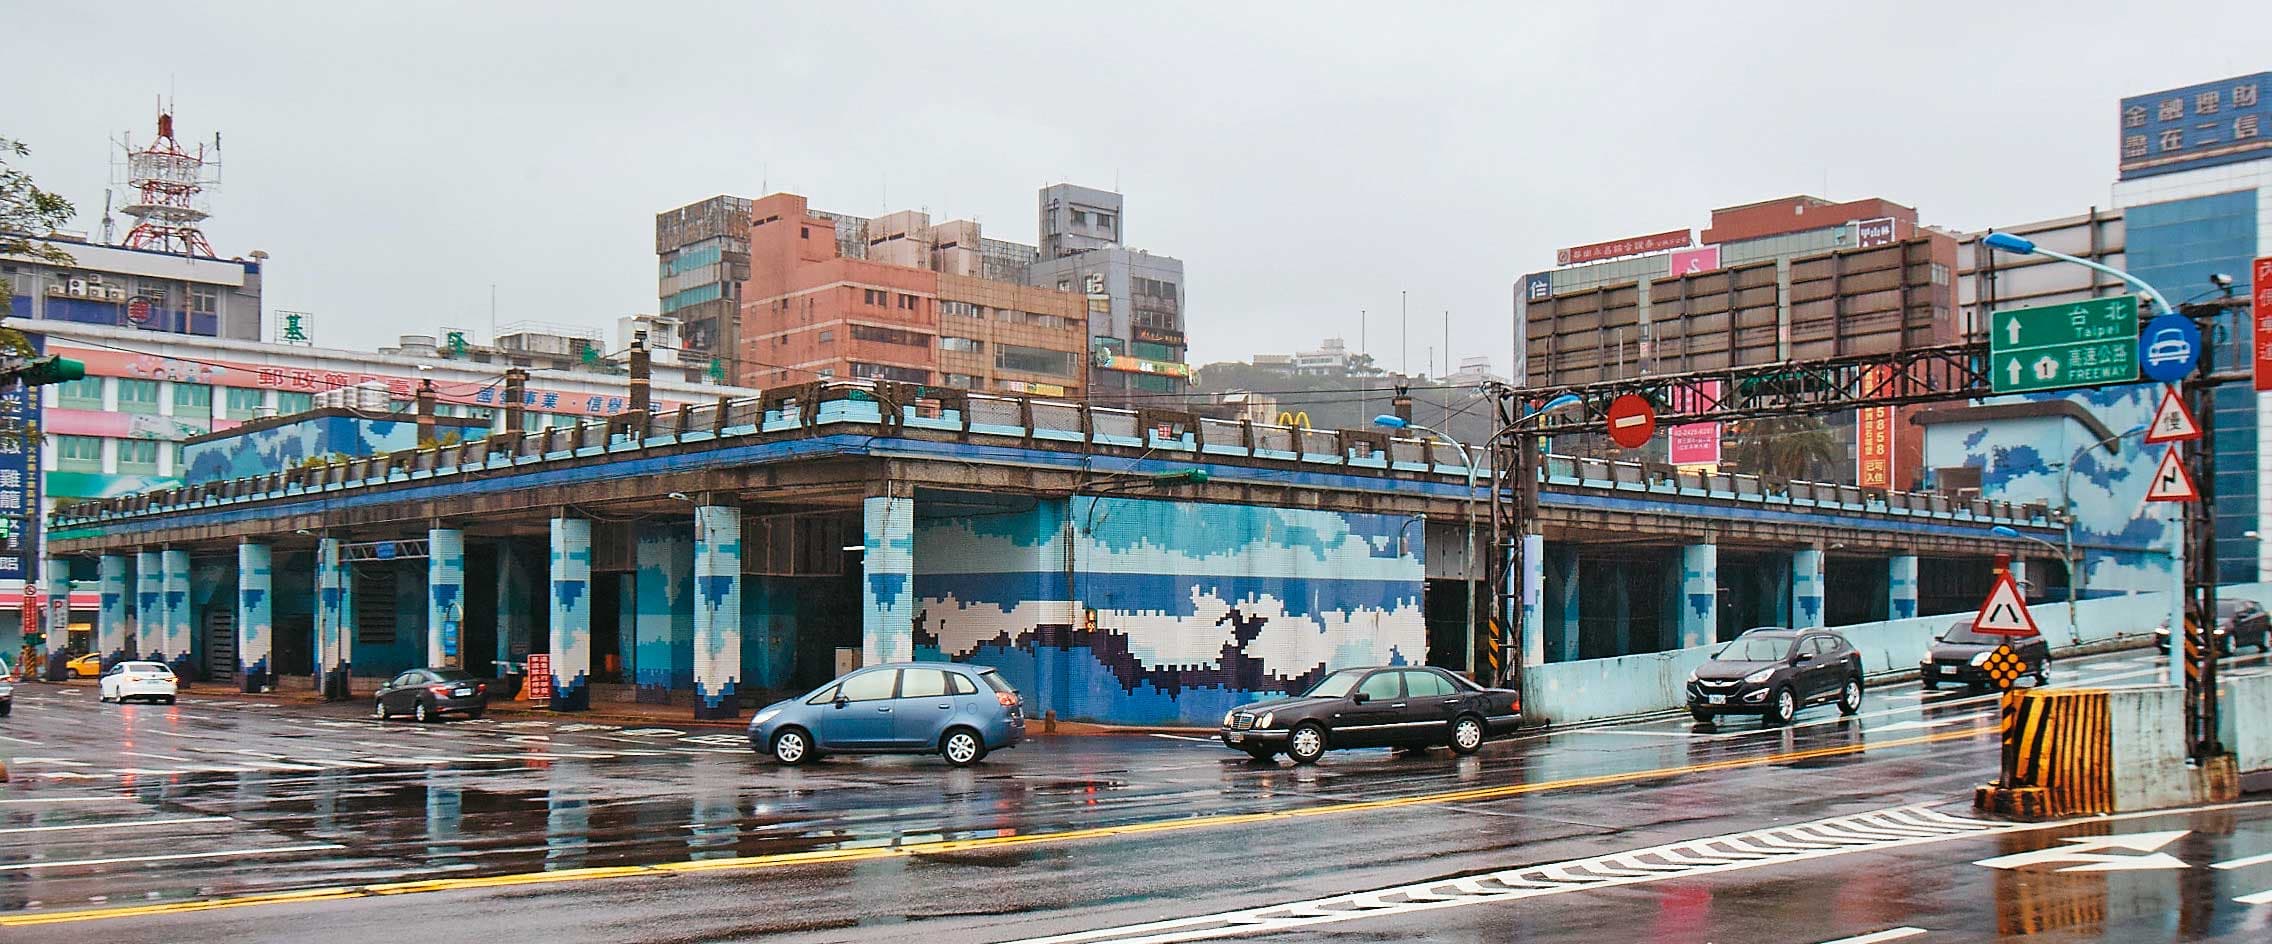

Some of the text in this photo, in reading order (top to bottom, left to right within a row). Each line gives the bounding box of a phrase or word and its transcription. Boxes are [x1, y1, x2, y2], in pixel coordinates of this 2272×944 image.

[2125, 84, 2258, 128] 金融理財
[2125, 115, 2258, 157] 盡在二信
[2068, 301, 2127, 326] 台北
[284, 313, 308, 342] 基
[2075, 325, 2120, 339] Taipei
[2068, 344, 2127, 367] 高速公路
[2042, 363, 2048, 376] 1
[2068, 365, 2129, 381] FREEWAY
[2163, 410, 2181, 432] 慢
